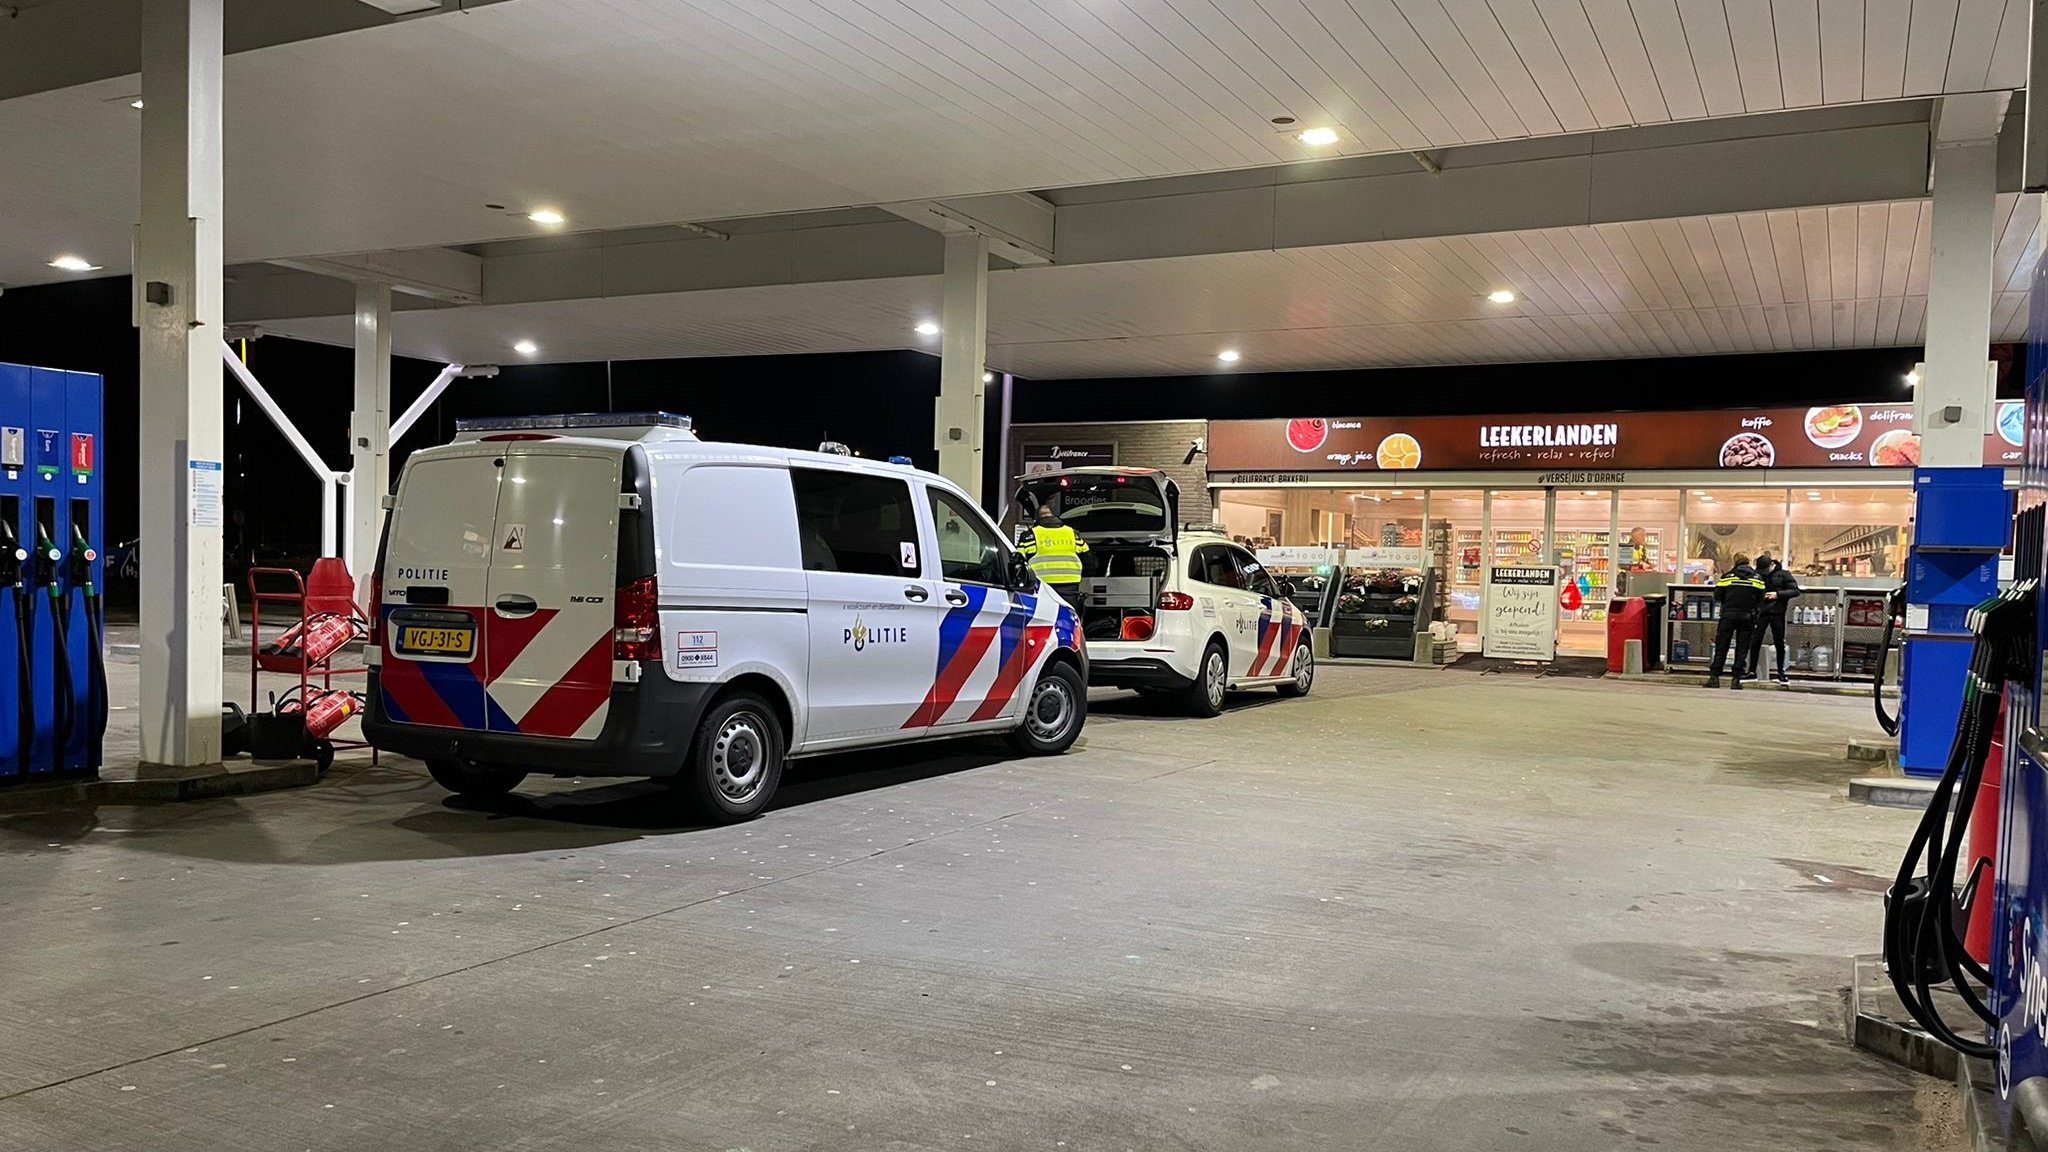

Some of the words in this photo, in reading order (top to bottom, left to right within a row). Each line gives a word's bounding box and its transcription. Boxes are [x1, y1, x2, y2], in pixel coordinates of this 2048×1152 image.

[1869, 410, 1914, 423] delifran
[1741, 417, 1773, 431] koffie
[1480, 424, 1618, 447] LEEKERLANDEN
[1479, 448, 1521, 463] refresh
[1537, 448, 1563, 461] relax
[1580, 448, 1616, 463] refuel
[1829, 451, 1863, 461] snacks
[1546, 473, 1569, 483] VERSE
[1570, 473, 1585, 483] JUS
[1587, 472, 1625, 483] D'ORANGE
[398, 568, 449, 580] POLITIE
[1495, 568, 1550, 579] LEEKERLANDEN
[1495, 601, 1545, 618] geopend!
[411, 629, 464, 649] VGJ-31-S
[692, 635, 704, 644] 112
[844, 627, 907, 652] POLITIE
